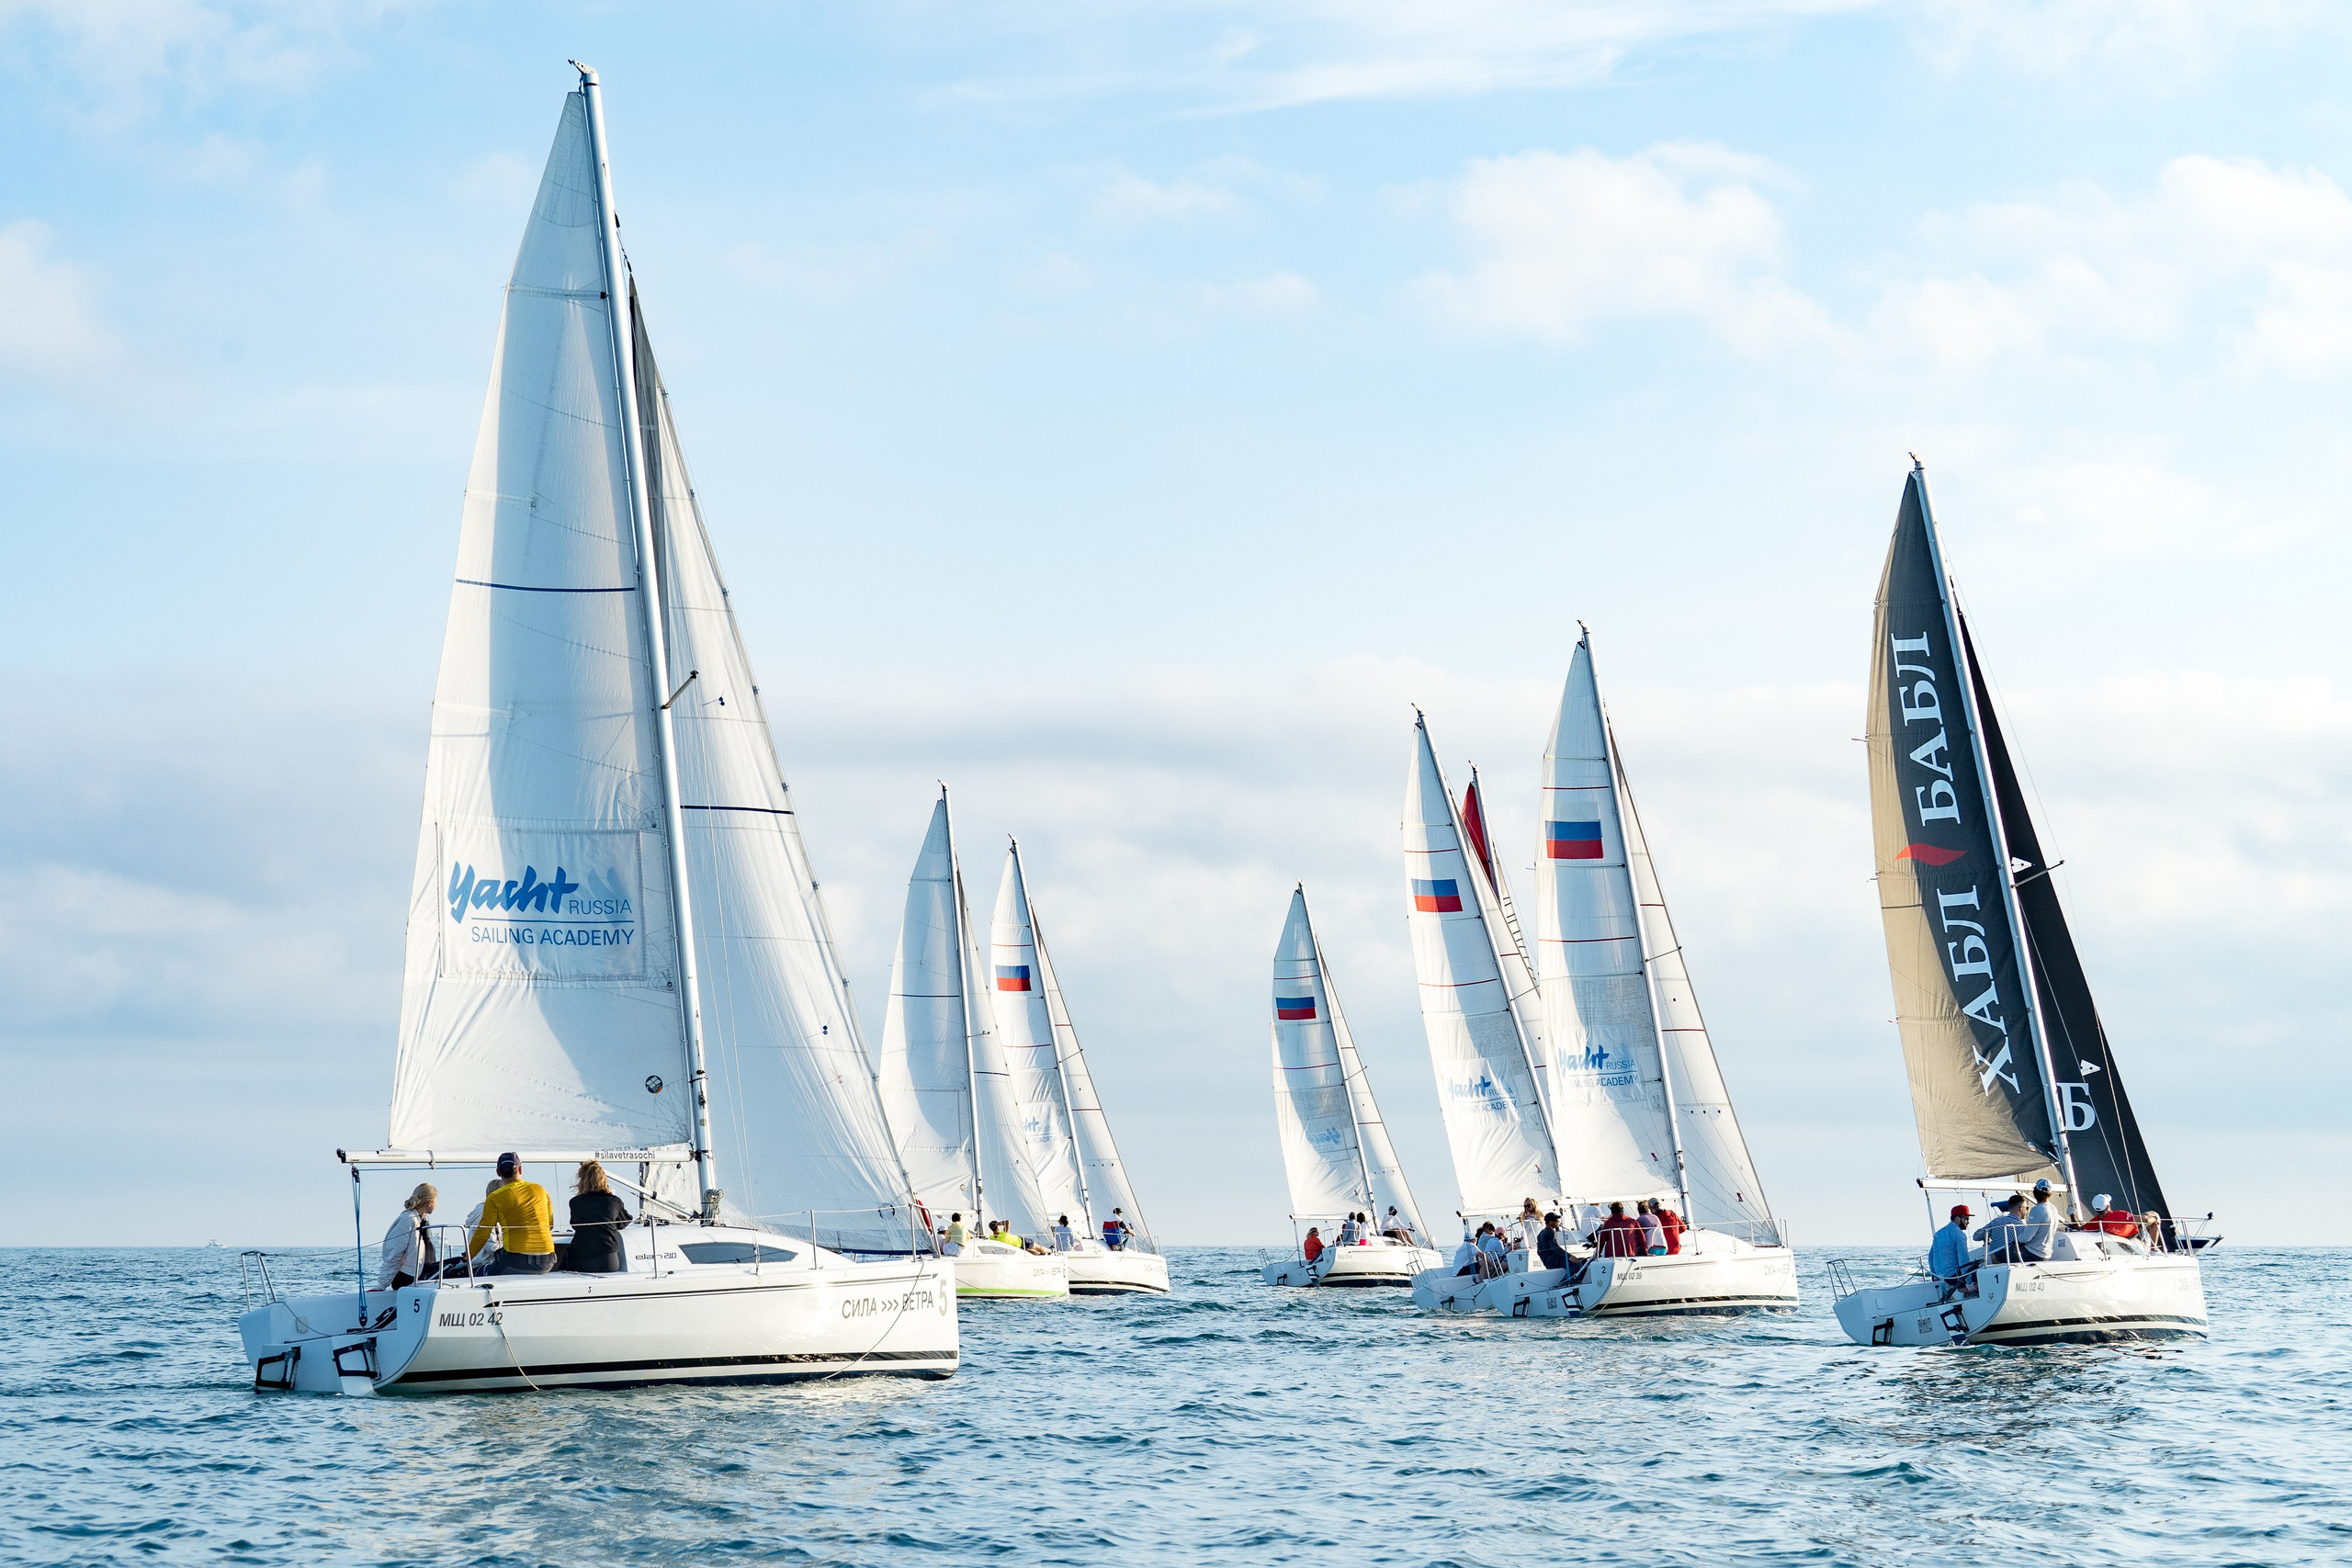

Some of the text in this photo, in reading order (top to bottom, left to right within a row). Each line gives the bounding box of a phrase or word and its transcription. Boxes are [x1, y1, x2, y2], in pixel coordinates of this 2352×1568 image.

[1891, 631, 1961, 827] БАБЛ
[569, 899, 633, 915] RUSSIA
[471, 926, 635, 946] SAILING ACADEMY
[1937, 885, 2020, 1097] ХАБЛ
[1606, 1059, 1636, 1070] RUSSIA
[1596, 1075, 1638, 1087] ACADEMY
[1488, 1088, 1513, 1097] RUIA
[594, 1150, 656, 1159] #silavetrasochi
[1601, 1266, 1607, 1274] 2
[1635, 1271, 1643, 1280] 39
[1994, 1273, 1999, 1284] 1
[2029, 1281, 2037, 1292] 02
[2037, 1281, 2045, 1292] 43
[938, 1279, 948, 1316] 5
[413, 1298, 421, 1314] 5
[842, 1297, 877, 1319] СИЛА
[902, 1291, 934, 1312] ВЕТРА
[439, 1312, 503, 1328] МЩ 02 42
